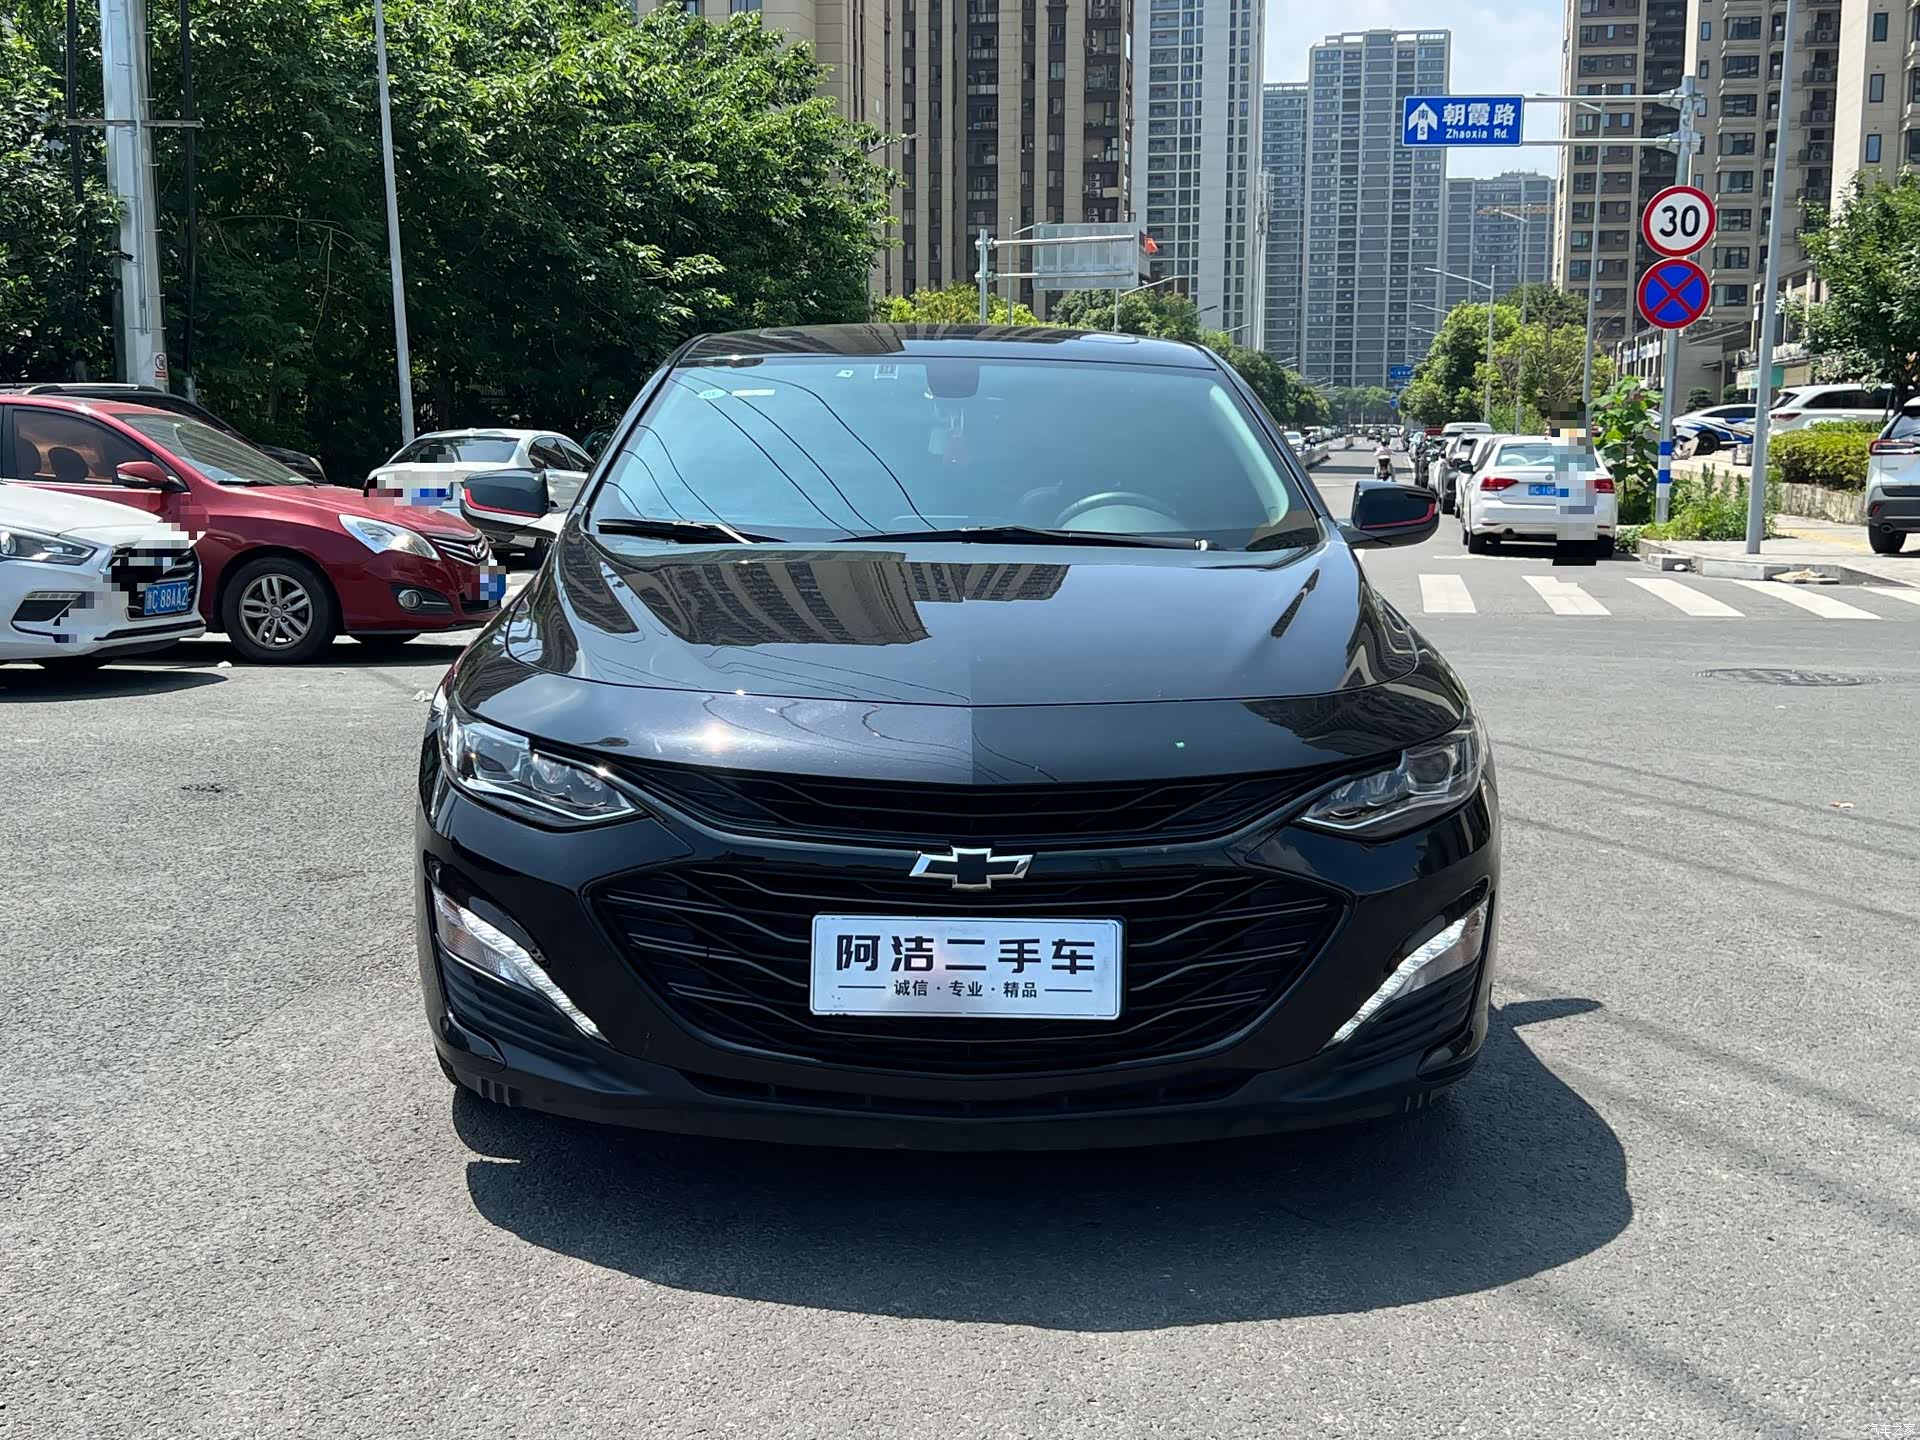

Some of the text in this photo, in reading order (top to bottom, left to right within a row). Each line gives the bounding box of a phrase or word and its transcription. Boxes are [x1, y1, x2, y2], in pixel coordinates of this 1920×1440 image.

[1442, 102, 1516, 126] 朝霞路
[1419, 126, 1426, 135] S
[1445, 128, 1488, 139] Zhaoxia
[1659, 205, 1701, 237] 30
[836, 934, 1096, 975] 阿洁二手车
